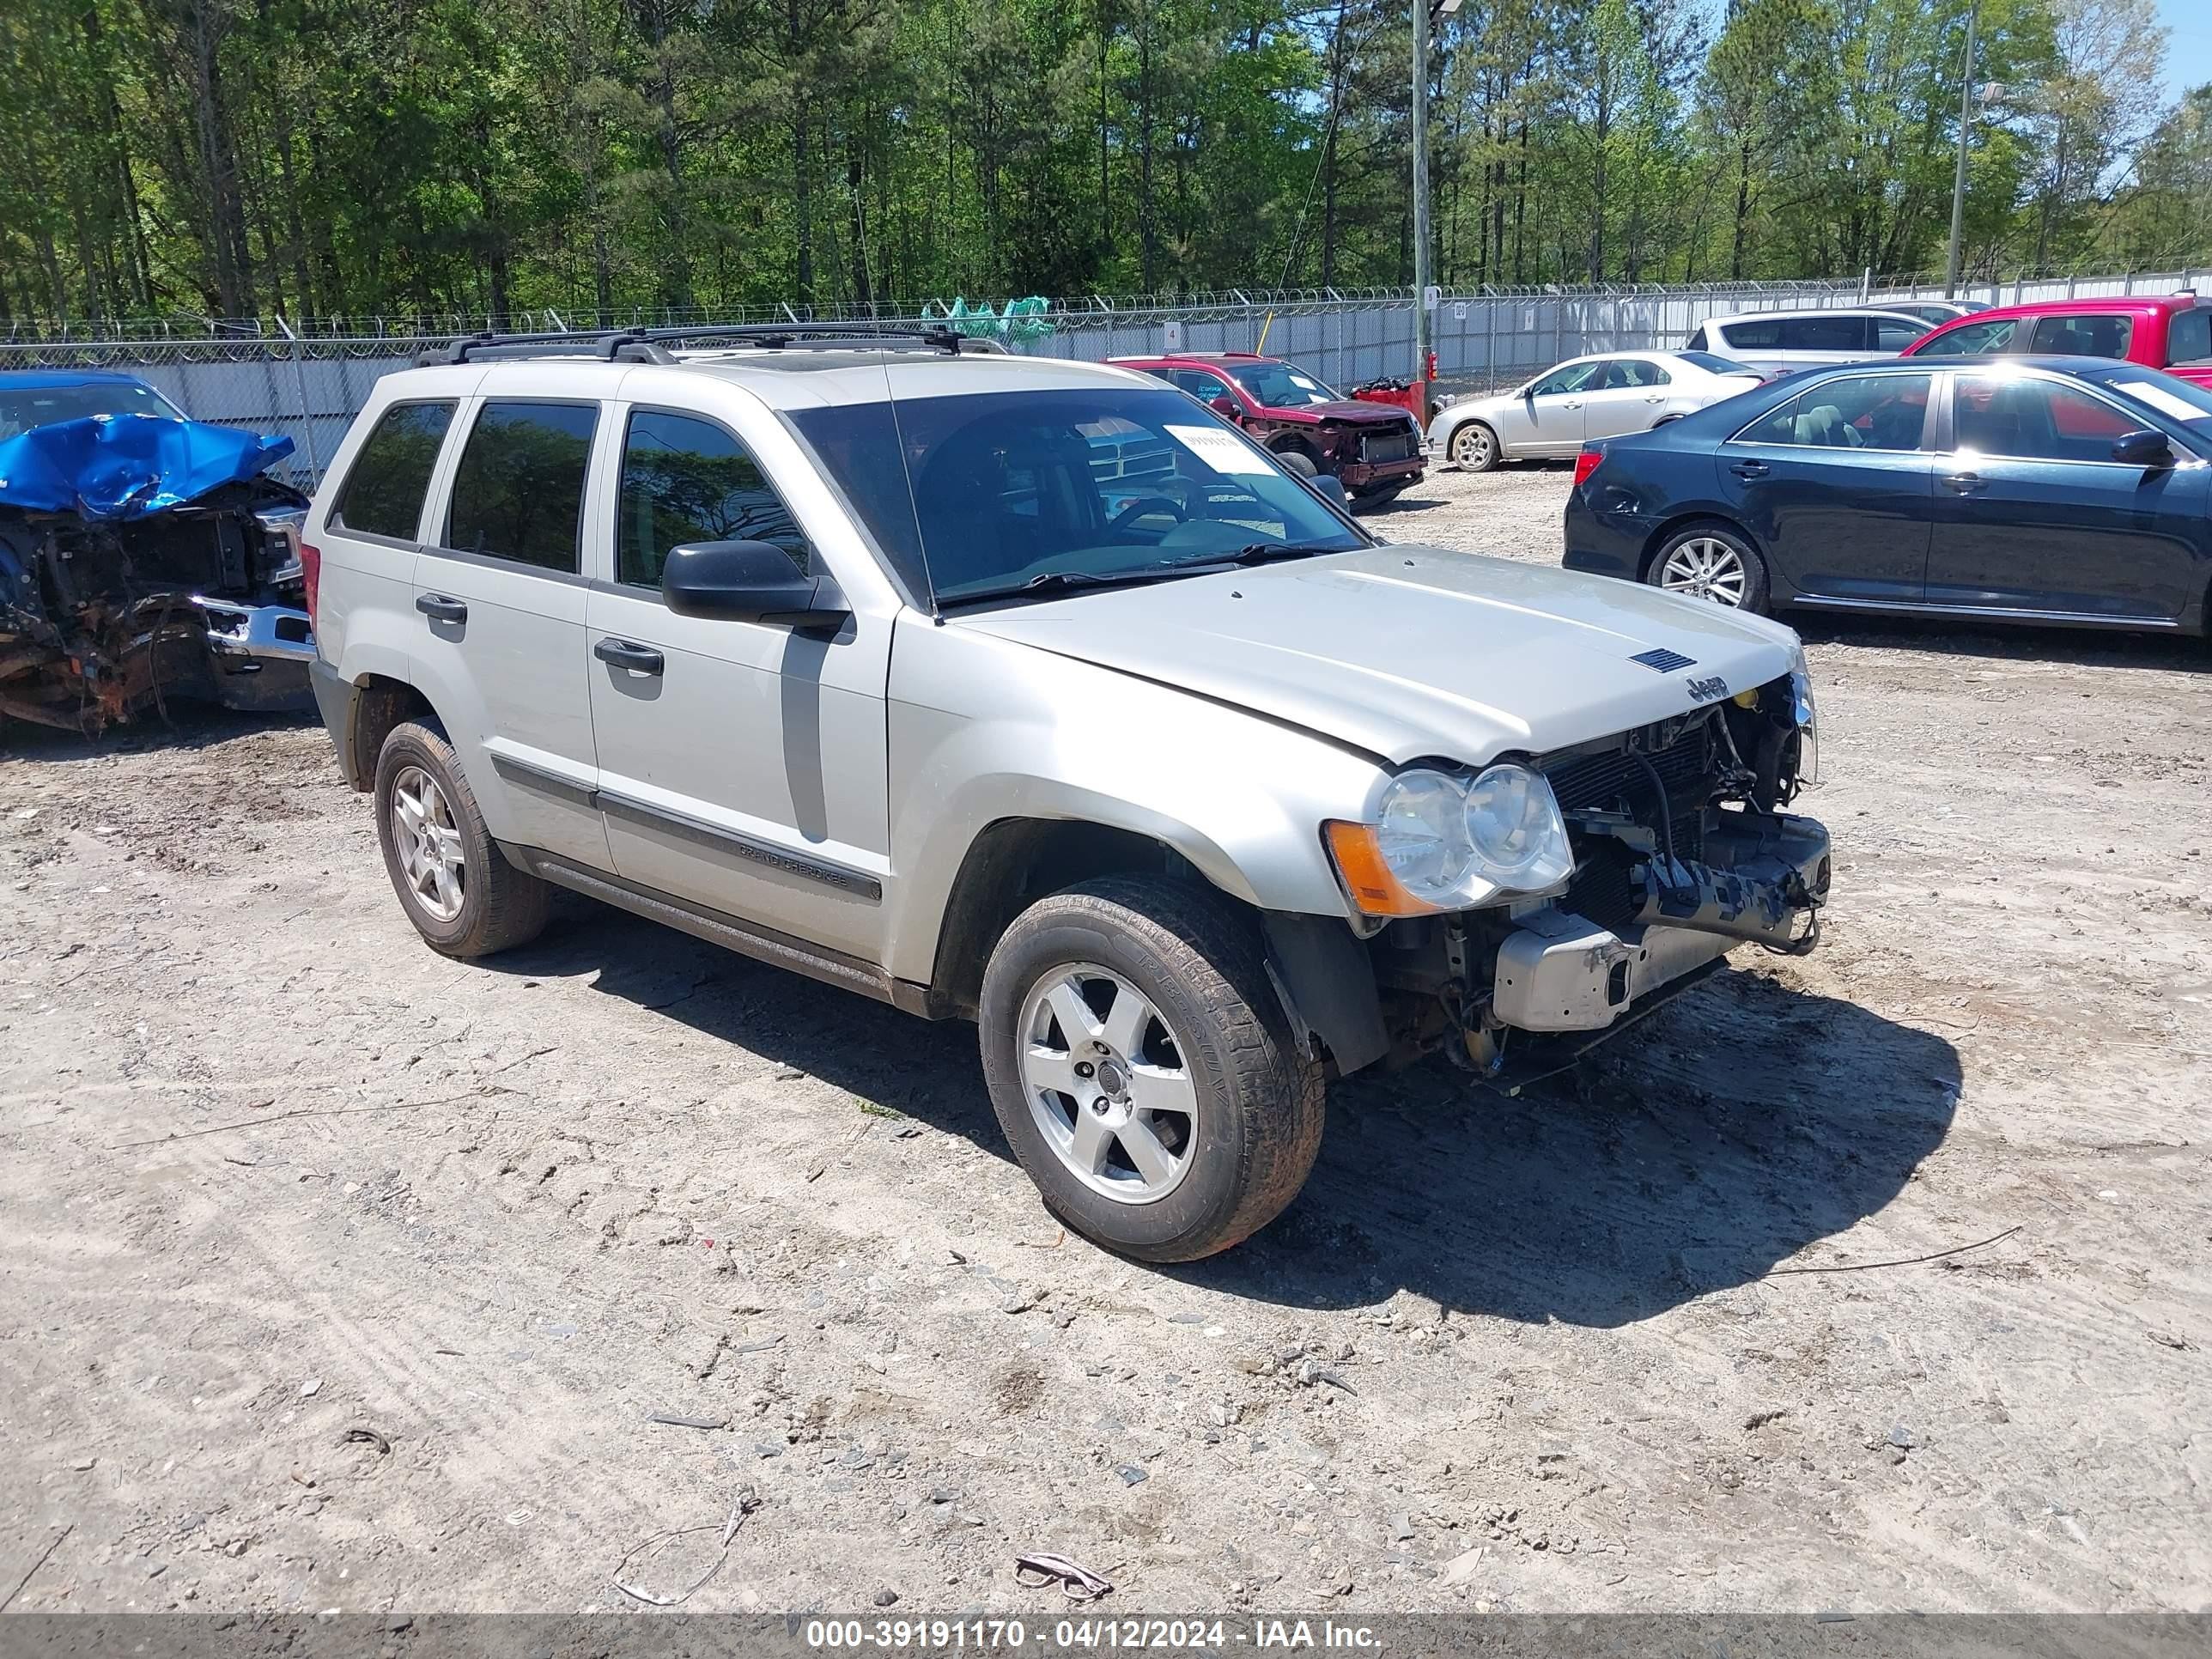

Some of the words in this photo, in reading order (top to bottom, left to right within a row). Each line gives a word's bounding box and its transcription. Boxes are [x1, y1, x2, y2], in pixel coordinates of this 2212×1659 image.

[1170, 329, 1176, 339] 4
[1686, 676, 1729, 703] Jeep
[741, 845, 779, 866] GRAND
[784, 860, 848, 887] CHEROKEE
